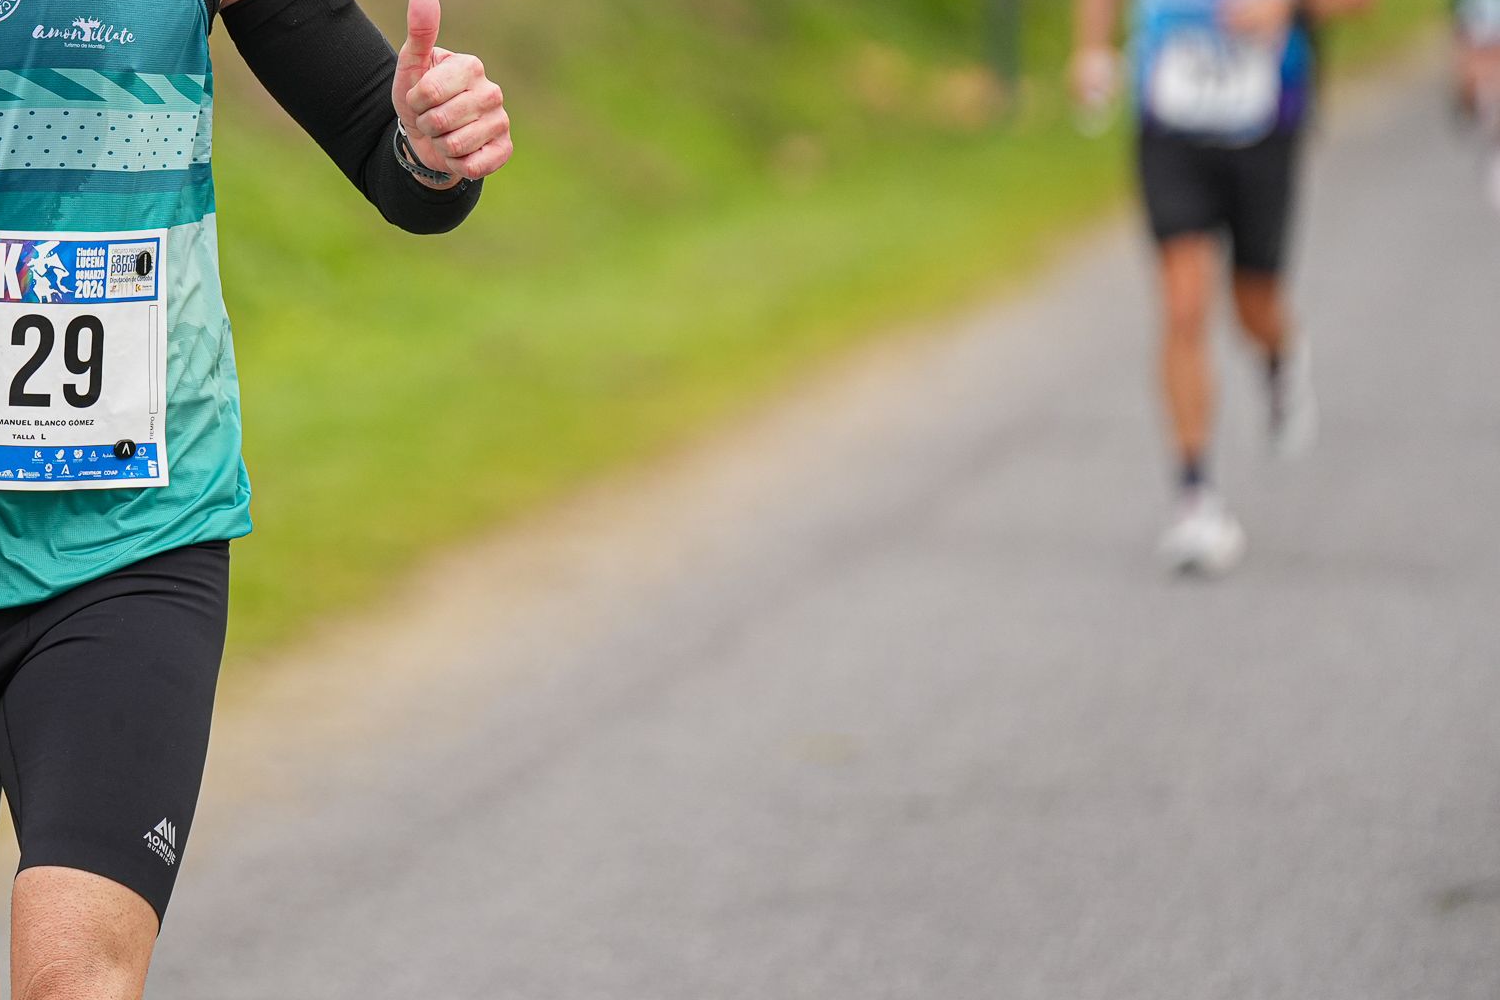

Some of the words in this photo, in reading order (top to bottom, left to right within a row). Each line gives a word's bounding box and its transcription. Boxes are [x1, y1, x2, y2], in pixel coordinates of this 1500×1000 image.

[76, 247, 98, 256] Ciudad
[98, 247, 105, 256] de
[76, 256, 105, 268] LUCENA
[84, 269, 105, 280] MARZO
[74, 280, 104, 299] 2026
